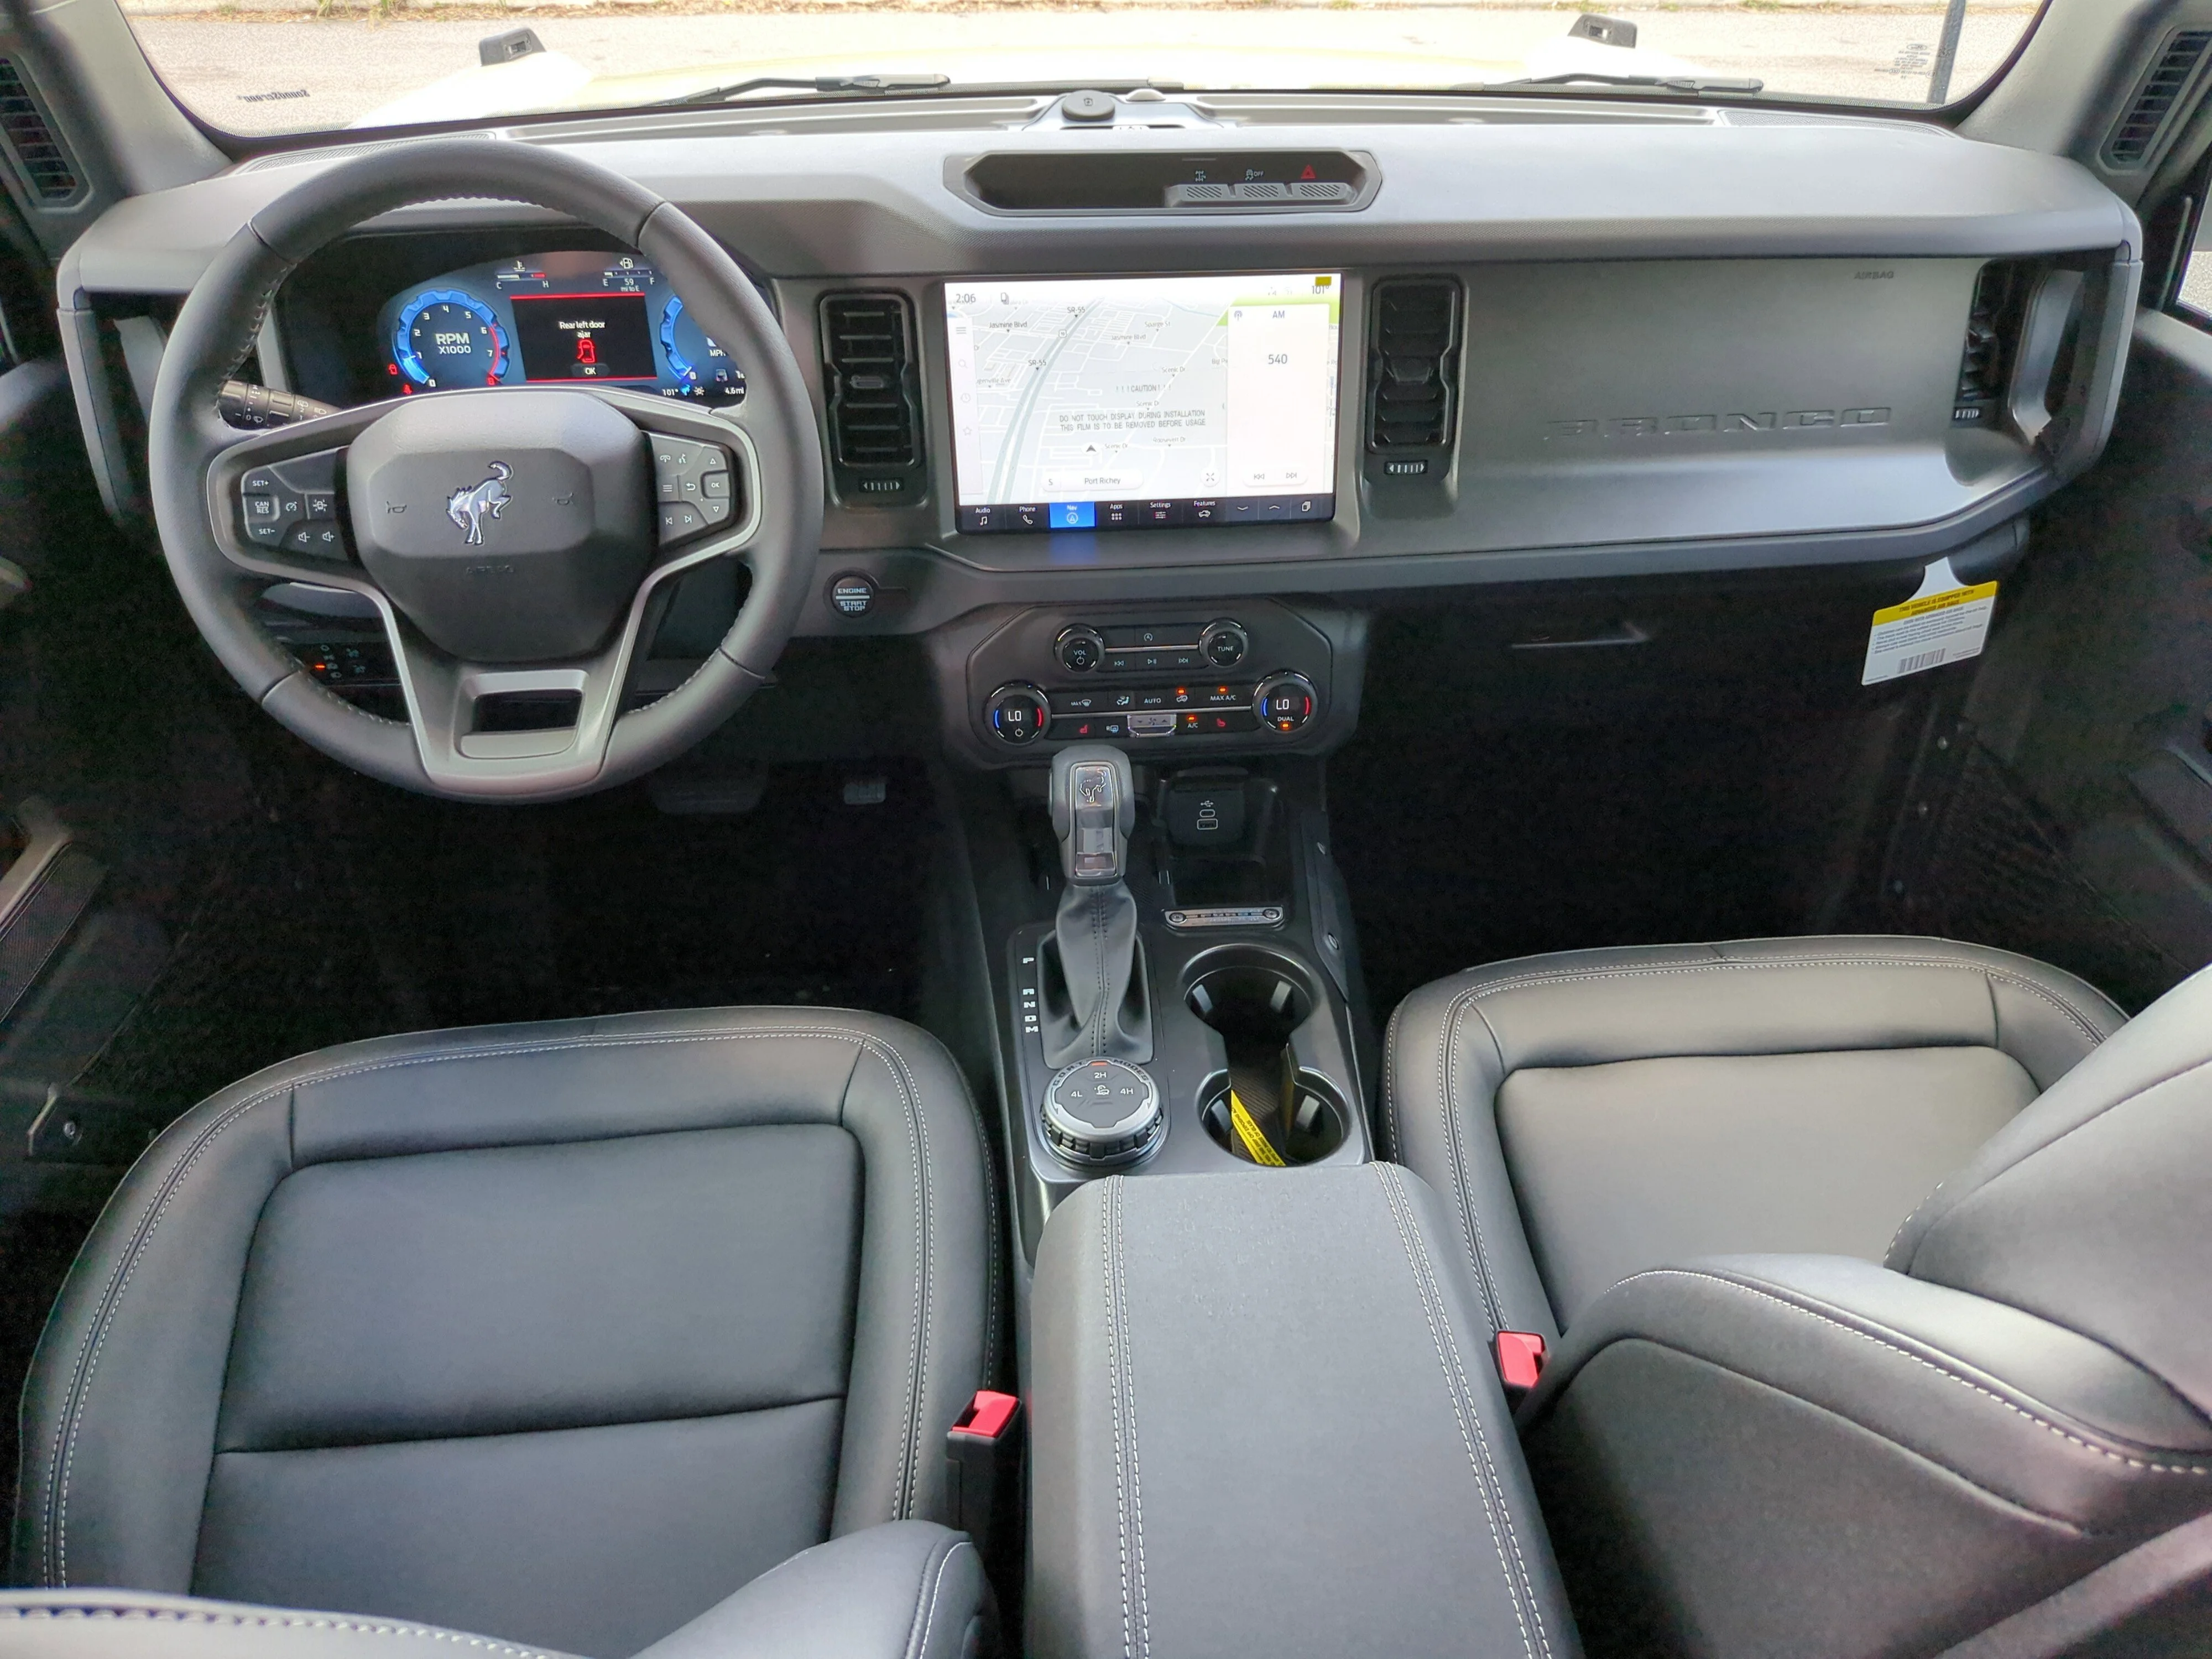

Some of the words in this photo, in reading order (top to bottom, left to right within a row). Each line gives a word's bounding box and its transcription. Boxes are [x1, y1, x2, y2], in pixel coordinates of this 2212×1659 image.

[625, 278, 634, 286] 59
[956, 293, 977, 303] 2:06
[1272, 310, 1285, 319] AM
[559, 321, 576, 330] Rear
[576, 321, 590, 329] left
[590, 320, 606, 329] door
[436, 332, 470, 345] RPM
[577, 331, 591, 340] ajar
[439, 346, 471, 354] X1000
[1267, 353, 1288, 364] 540
[487, 376, 495, 385] 8
[689, 372, 697, 380] 0
[429, 379, 436, 387] 0
[1164, 410, 1205, 418] INSTALLATION
[1543, 407, 1892, 441] BRONCO
[1099, 477, 1121, 485] Richey
[1276, 699, 1290, 710] LO
[1008, 710, 1022, 721] LO
[1113, 1059, 1149, 1081] MODES
